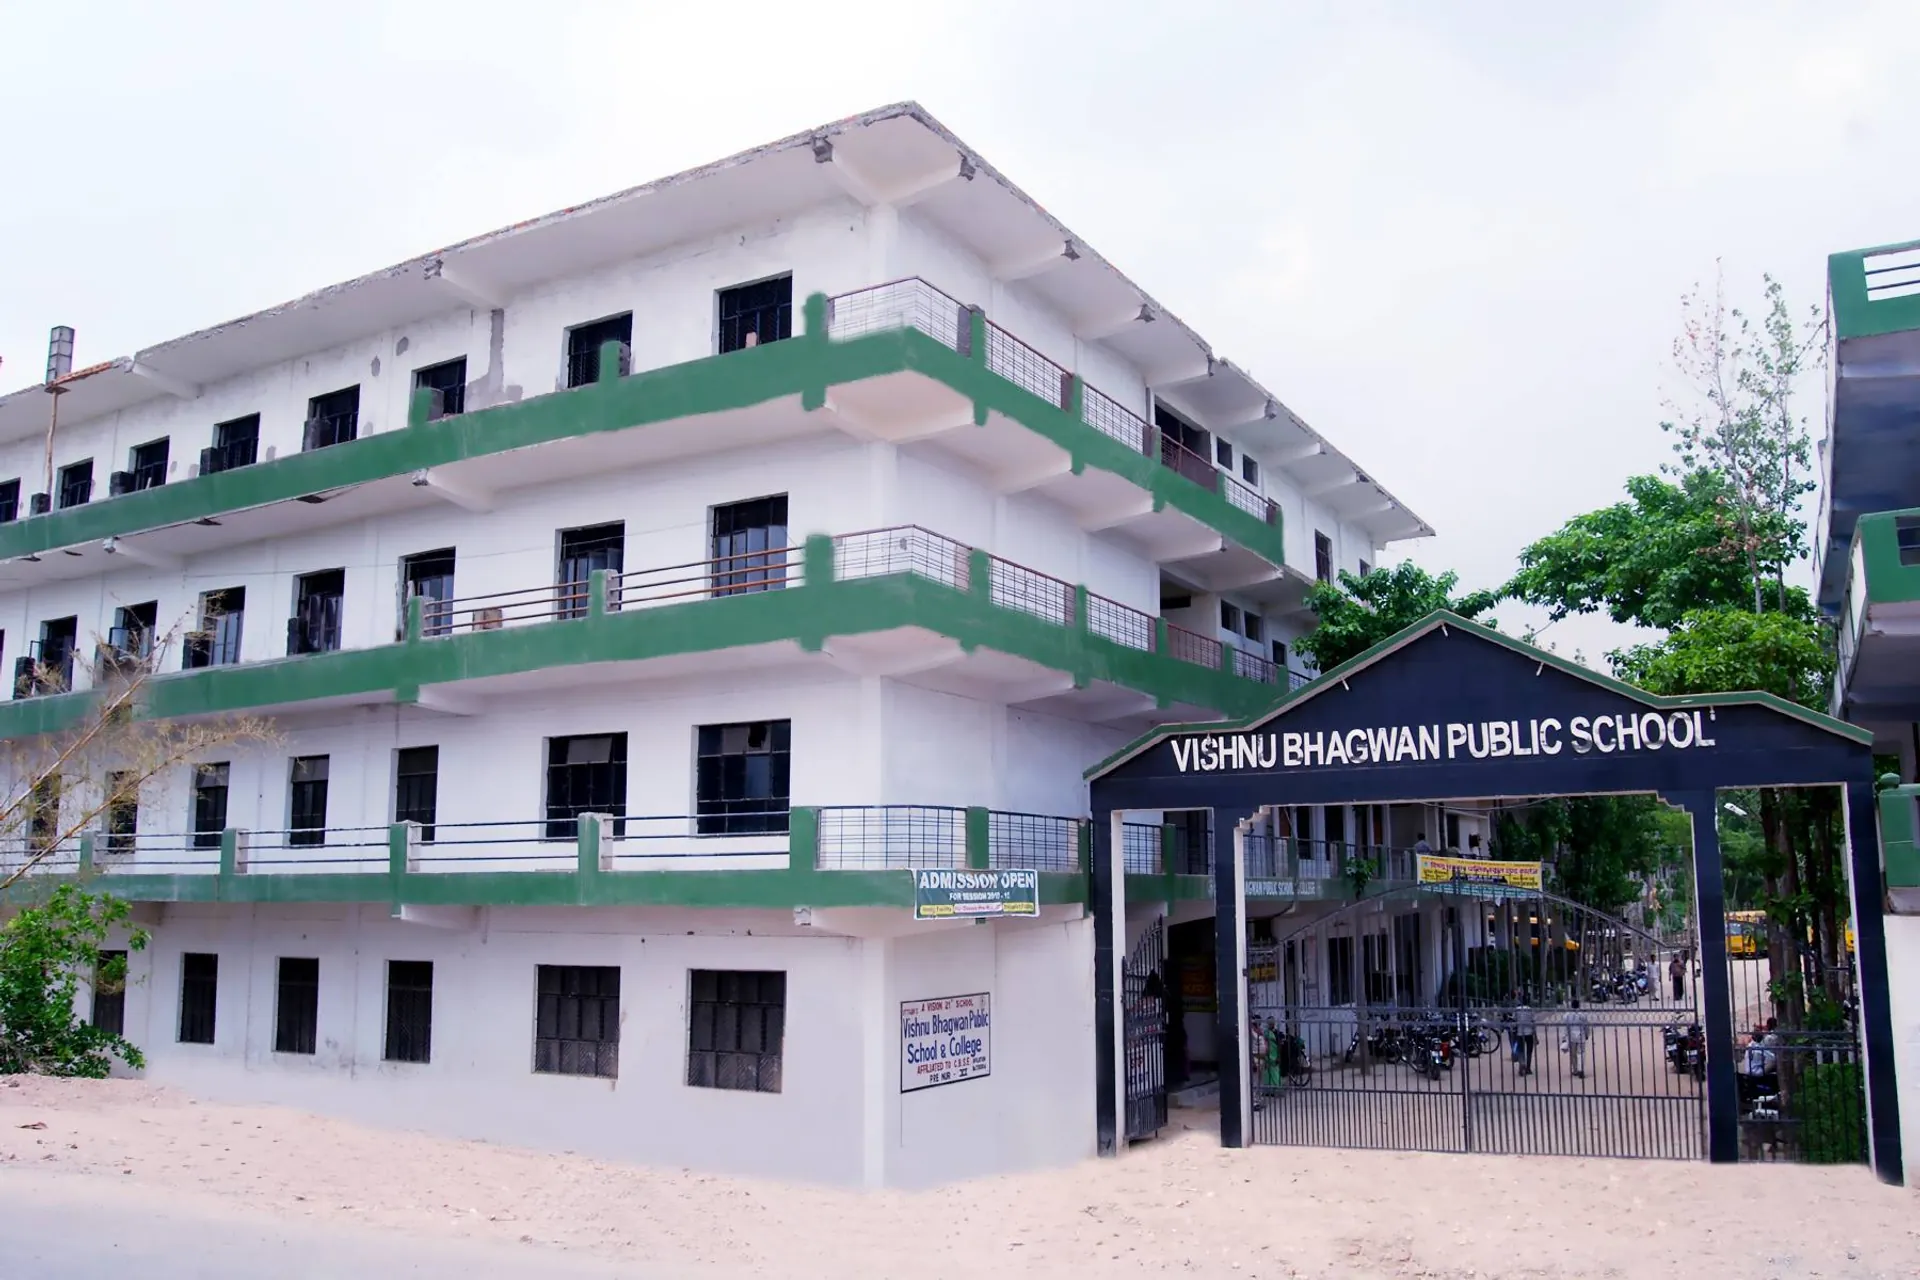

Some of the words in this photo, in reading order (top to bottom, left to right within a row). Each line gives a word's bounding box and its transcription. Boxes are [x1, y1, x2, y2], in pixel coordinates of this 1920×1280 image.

[1171, 732, 1276, 773] VISHNU
[1283, 724, 1439, 767] BHAGWAN
[1446, 717, 1563, 759] PUBLIC
[1569, 710, 1716, 754] SCHOOL
[920, 872, 998, 889] ADMISSION
[1001, 872, 1035, 889] OPEN
[949, 892, 961, 900] FOR
[962, 892, 986, 900] SESSION
[927, 1001, 943, 1011] VISION
[956, 999, 974, 1008] SCHOOL
[903, 1017, 930, 1038] Vishnu
[932, 1014, 968, 1036] Bhagwan
[969, 1008, 988, 1030] Public
[908, 1040, 937, 1064] School
[940, 1044, 946, 1058] &
[949, 1035, 982, 1057] College
[945, 1060, 952, 1069] TO
[930, 1074, 939, 1083] PRE
